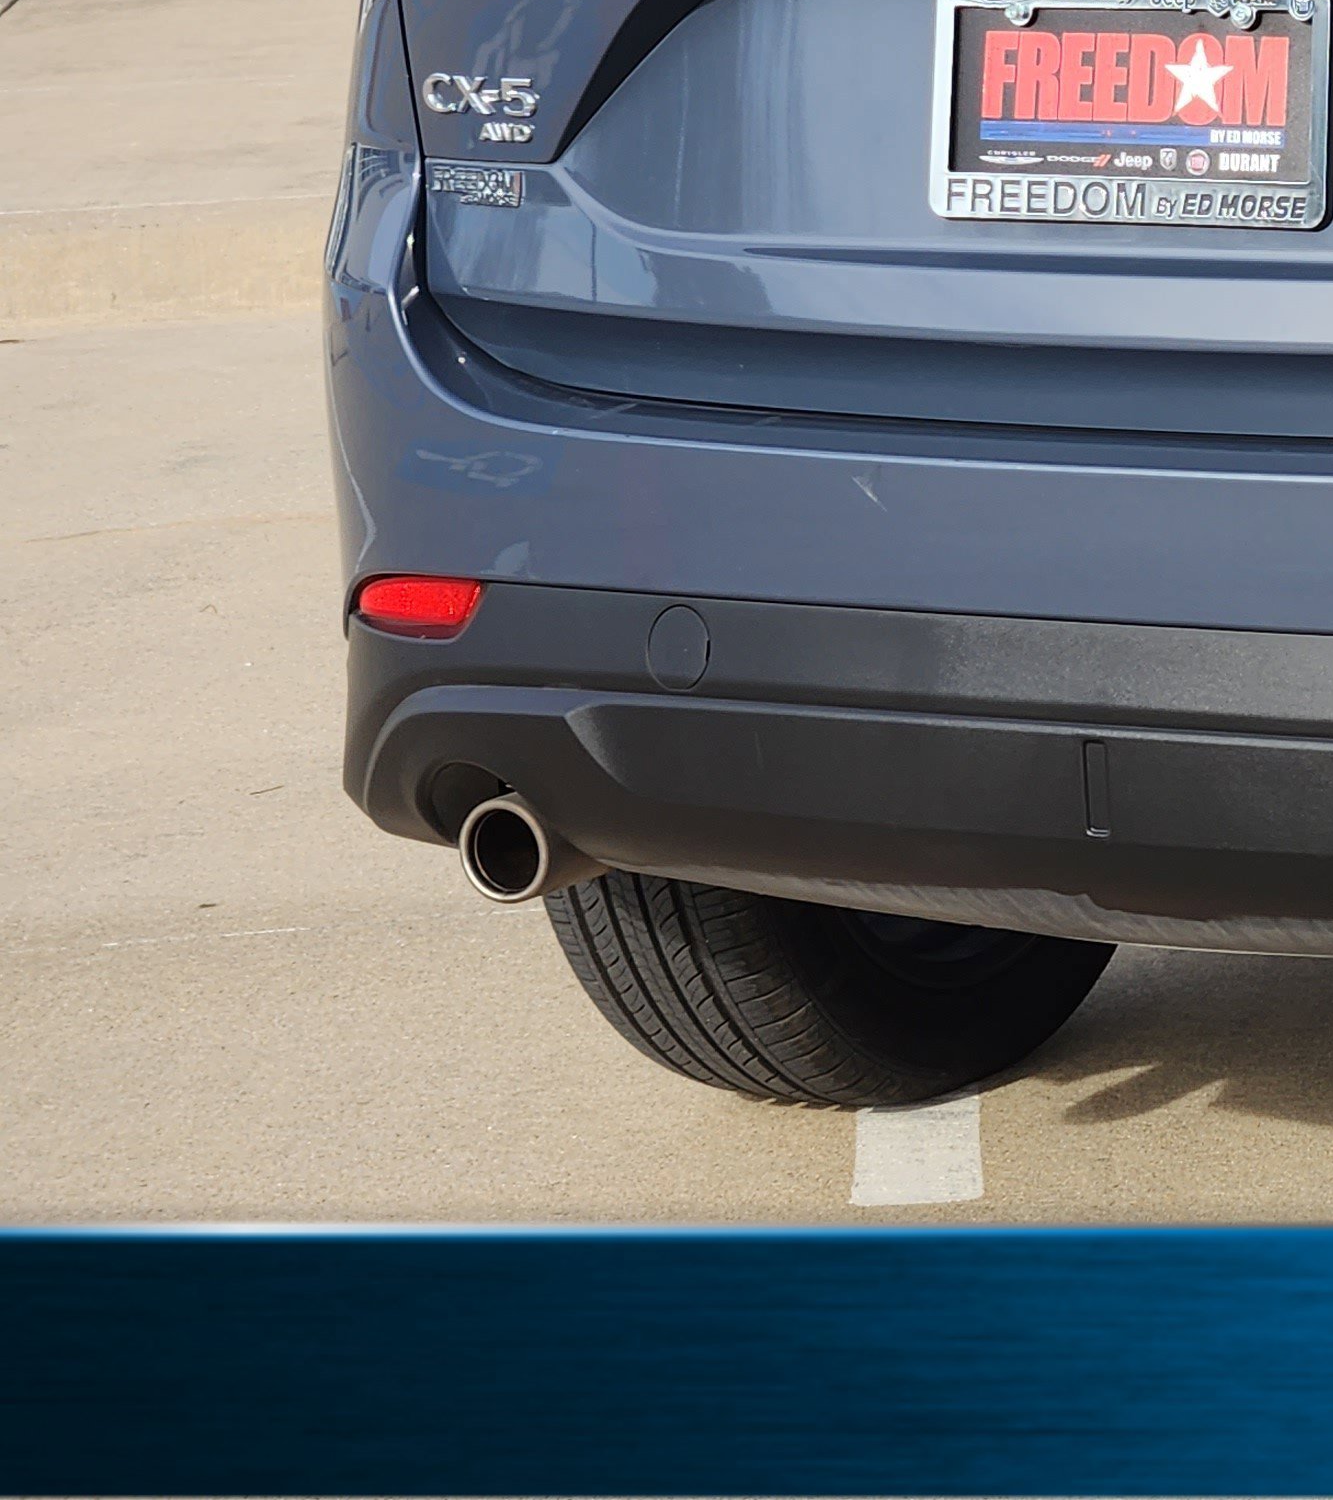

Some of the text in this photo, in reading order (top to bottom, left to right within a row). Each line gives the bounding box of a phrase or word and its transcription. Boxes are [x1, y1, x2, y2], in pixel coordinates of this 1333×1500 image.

[980, 30, 1290, 126] FREEDOM
[422, 72, 540, 117] CX-5
[479, 122, 534, 142] AWD
[1242, 130, 1281, 145] MORSE
[1114, 152, 1153, 171] Jeep
[1218, 152, 1281, 173] DURANT
[946, 178, 1147, 218] FREEDOM
[1182, 193, 1212, 216] ED
[1218, 194, 1306, 220] MORSE
